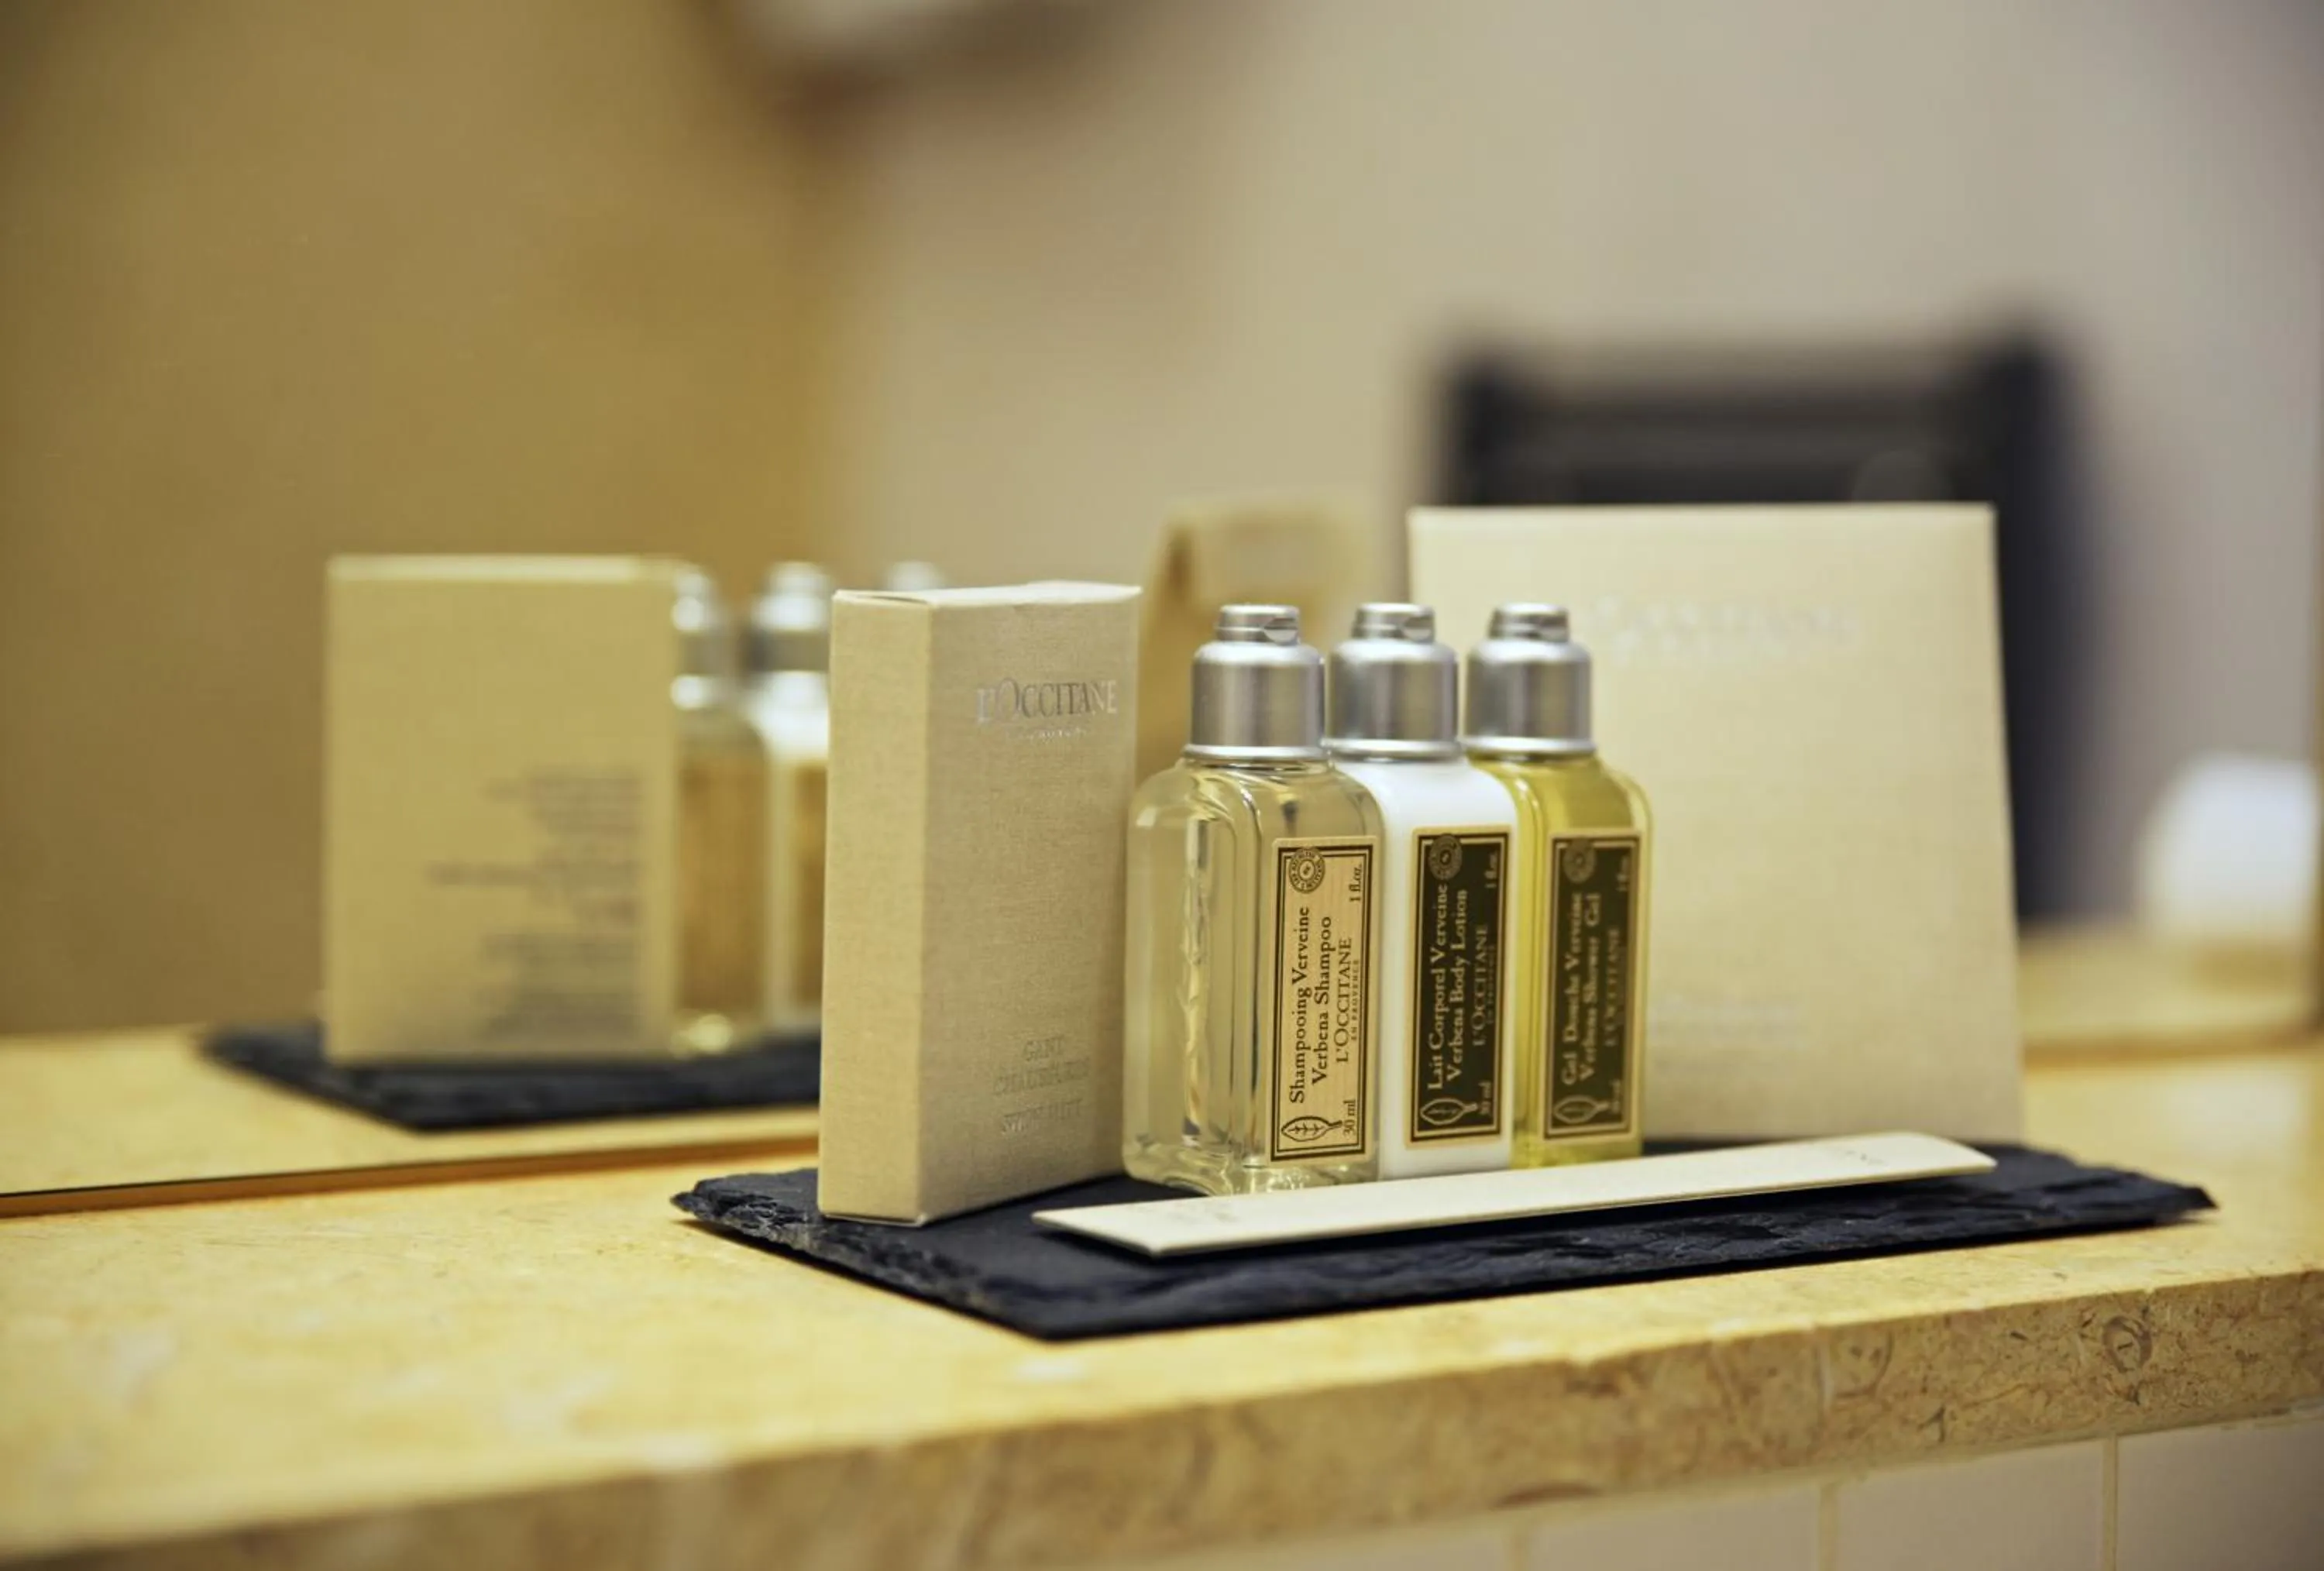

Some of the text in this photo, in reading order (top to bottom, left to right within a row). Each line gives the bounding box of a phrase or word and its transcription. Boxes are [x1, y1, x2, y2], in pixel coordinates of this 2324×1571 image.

[1291, 906, 1309, 985] Verveine
[1430, 883, 1448, 964] Verveine
[1564, 892, 1582, 971] Verveine
[1312, 916, 1336, 1086] Verbena Shampoo
[1334, 938, 1352, 1063] L'OCCITANE
[1428, 968, 1449, 1050] Corporel
[1446, 889, 1470, 1081] Verbena Body Lotion
[1471, 924, 1487, 1046] L'OCCITANE
[1563, 974, 1580, 1043] Douche
[1580, 893, 1601, 1081] Verbena Shower Gel
[1289, 987, 1312, 1104] Shampooing
[1427, 1054, 1443, 1090] Lait
[1561, 1052, 1577, 1085] Gel
[1343, 1099, 1356, 1136] 30 ml
